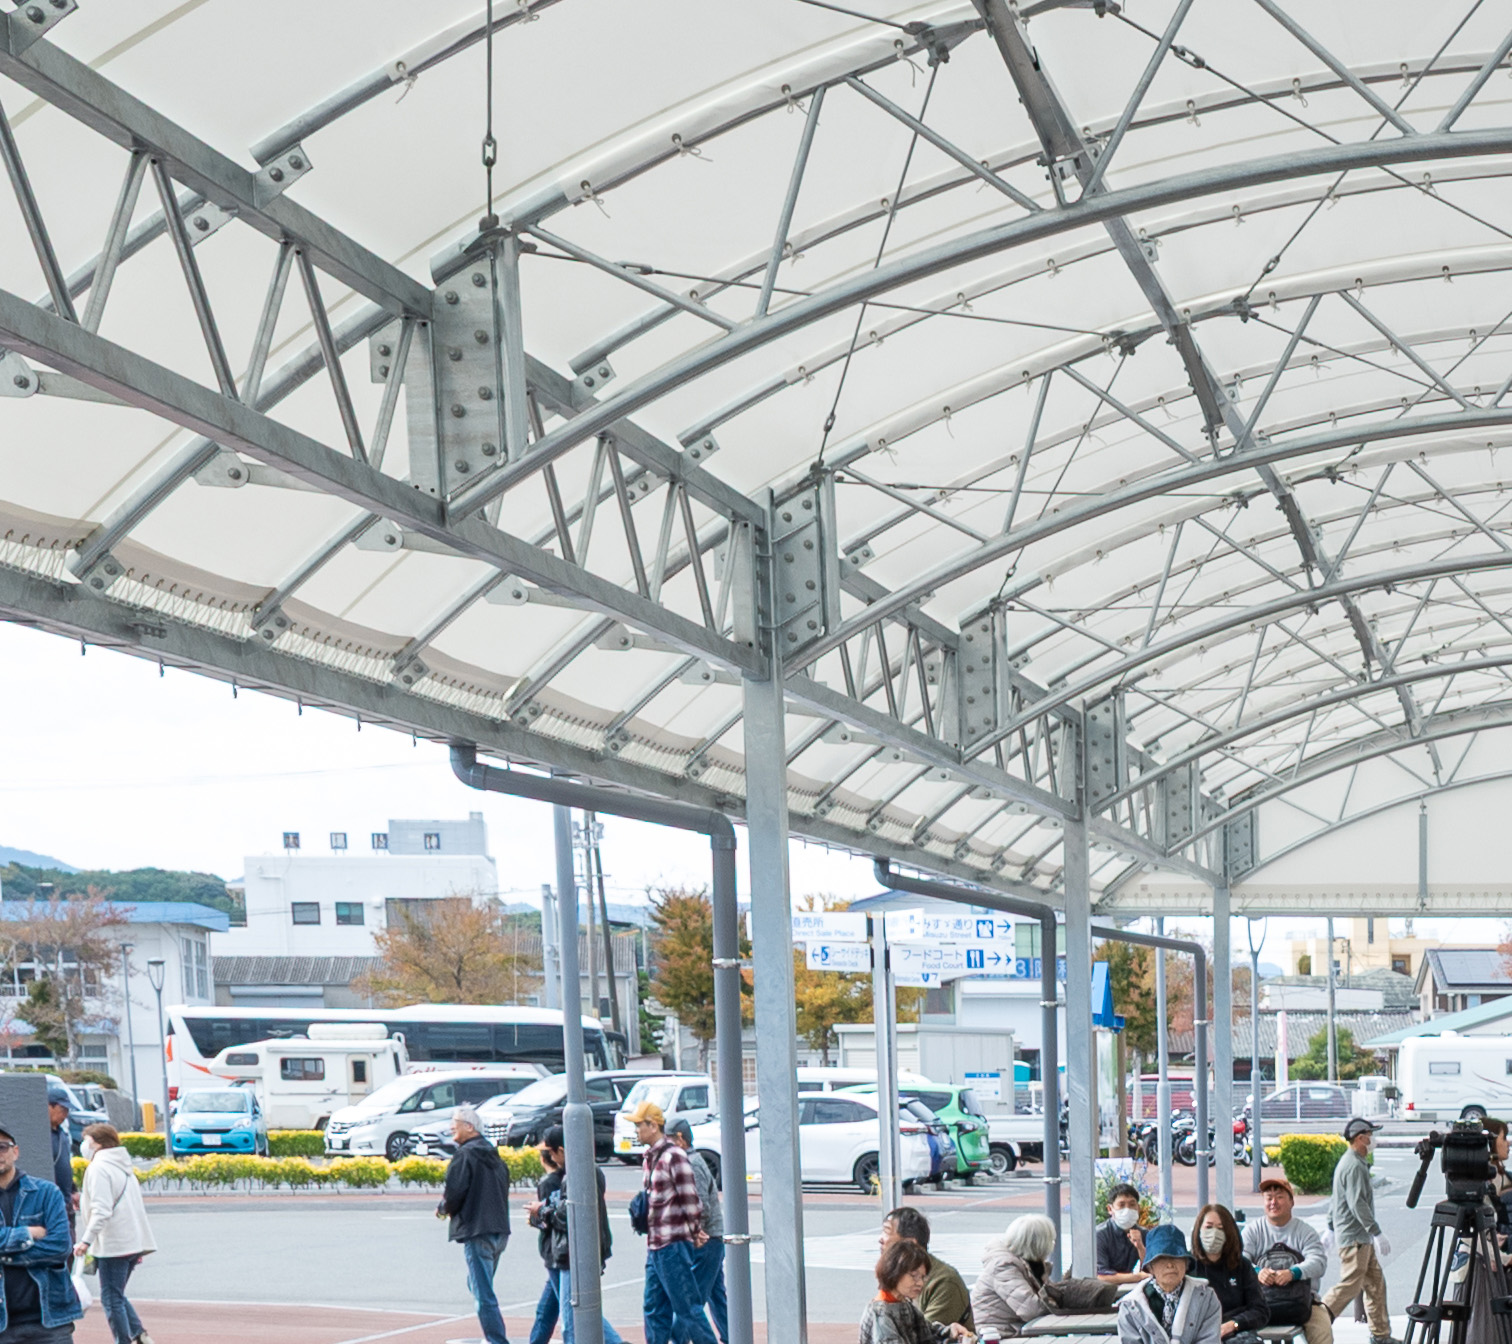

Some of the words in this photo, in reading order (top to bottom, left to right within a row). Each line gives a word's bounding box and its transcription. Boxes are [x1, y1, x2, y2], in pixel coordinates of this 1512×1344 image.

[901, 949, 963, 960] フードコート
